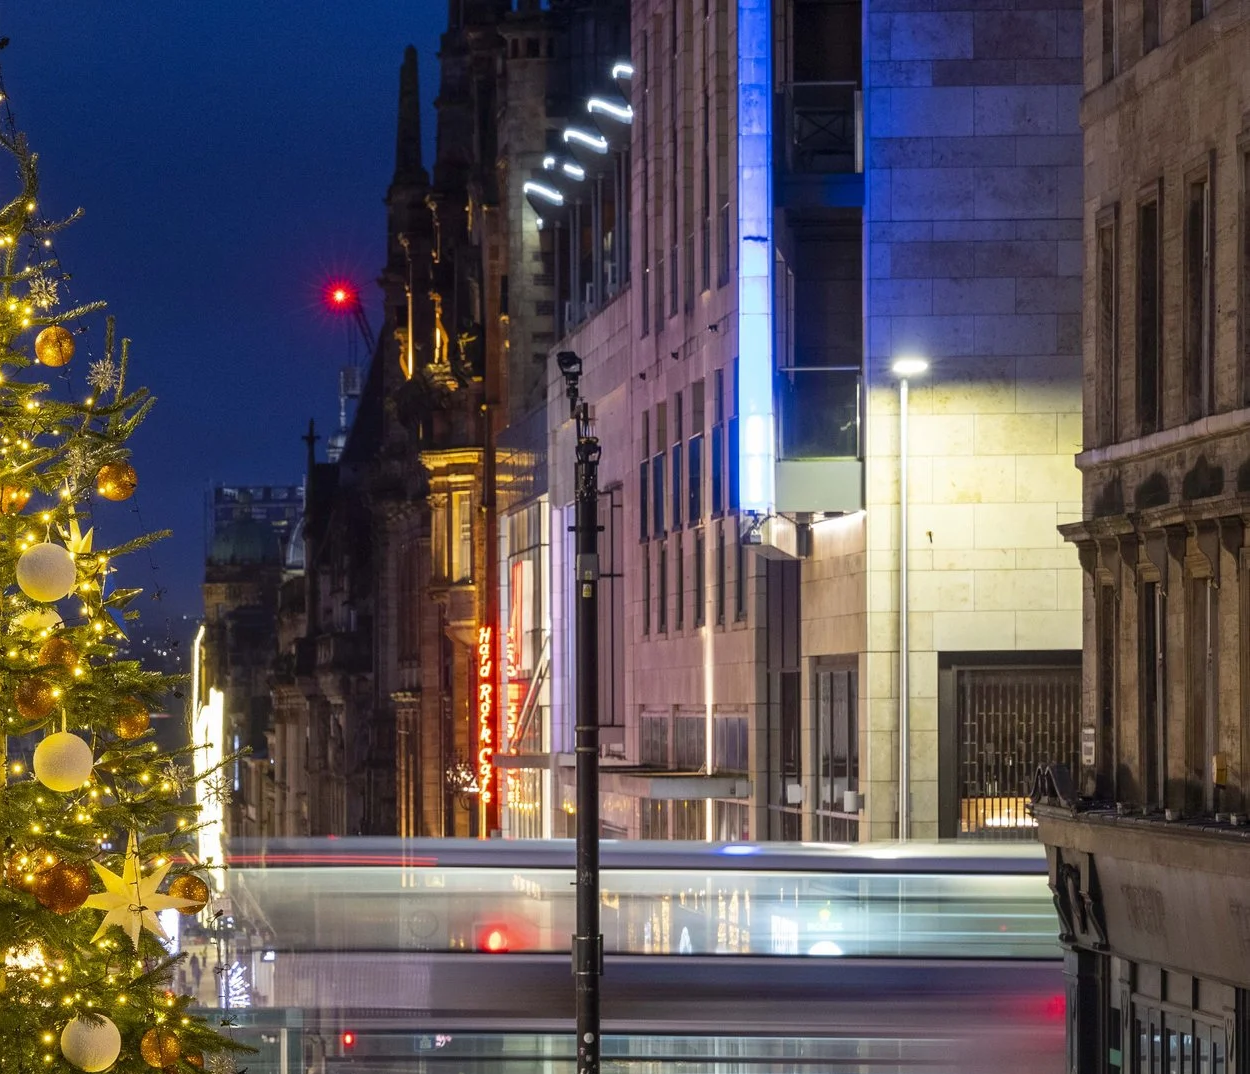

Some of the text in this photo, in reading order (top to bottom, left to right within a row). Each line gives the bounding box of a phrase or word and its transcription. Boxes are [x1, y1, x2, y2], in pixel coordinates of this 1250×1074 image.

[478, 627, 493, 803] Hard Rock Cafe
